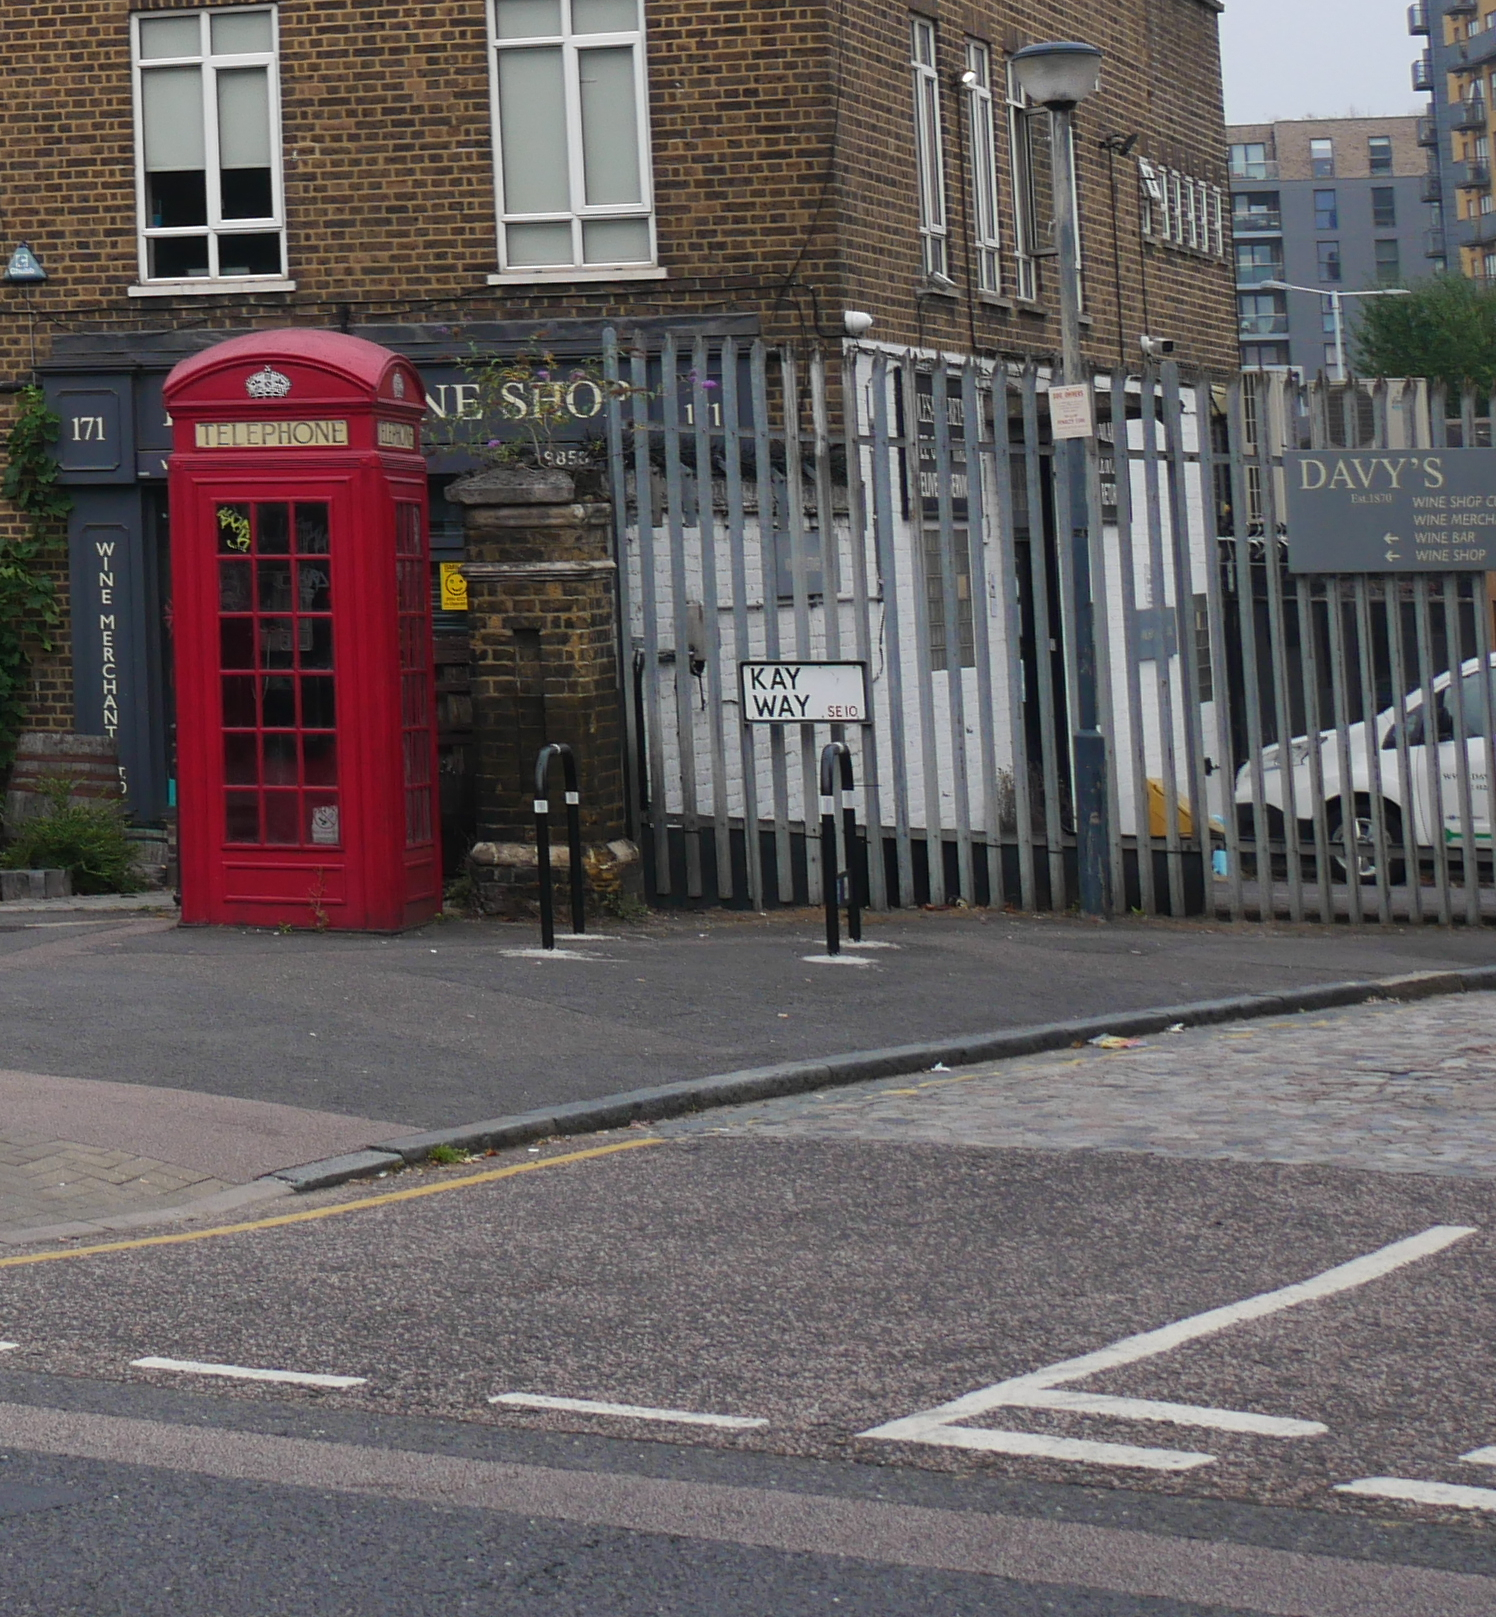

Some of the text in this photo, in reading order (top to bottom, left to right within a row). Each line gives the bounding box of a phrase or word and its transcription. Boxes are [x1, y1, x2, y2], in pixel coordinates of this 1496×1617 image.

[684, 402, 721, 427] 11
[71, 416, 106, 441] 171
[199, 421, 345, 446] TELEPHONE
[1298, 457, 1444, 489] DAVY'S
[1412, 495, 1447, 508] WINE
[1450, 495, 1482, 508] SHOP
[1413, 513, 1496, 526] WINE MERCH
[1414, 531, 1475, 544] WINE BAR
[1415, 548, 1486, 561] WINE SHOP
[95, 541, 118, 739] WINE MERCHANT
[750, 667, 801, 690] KAY
[752, 694, 810, 717] WAY
